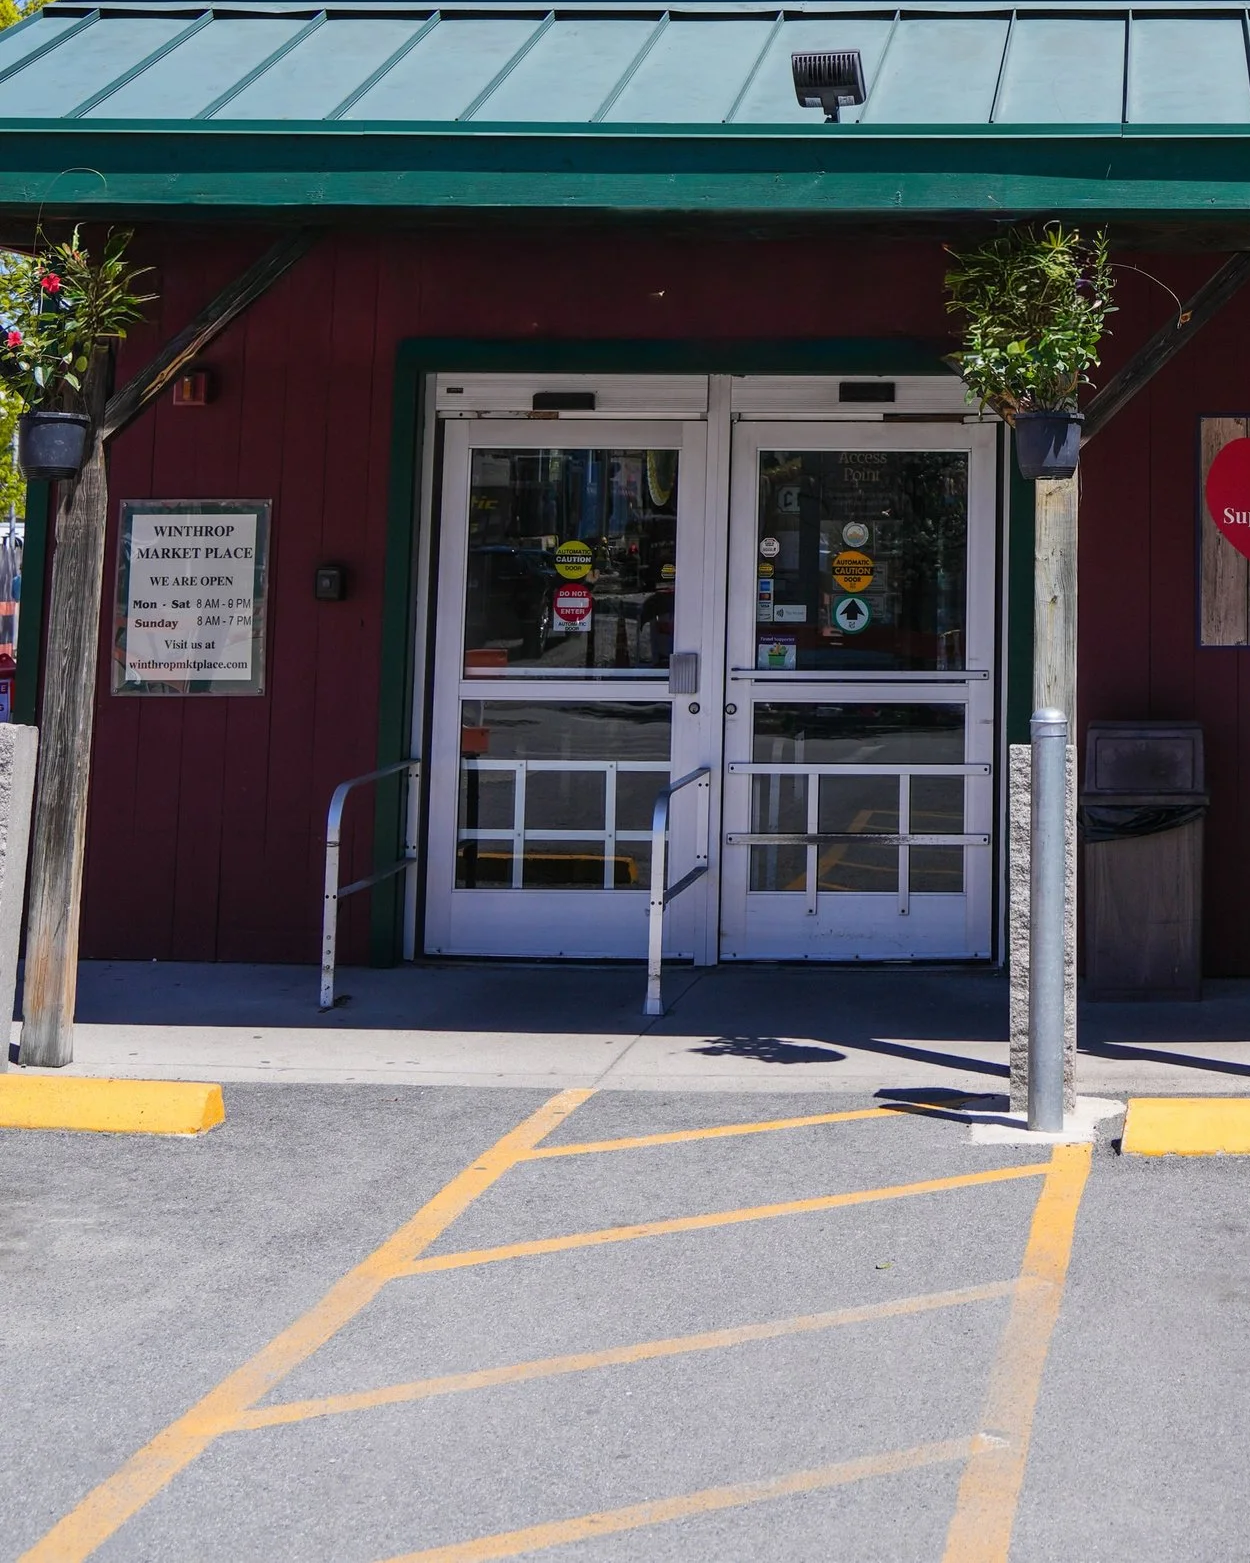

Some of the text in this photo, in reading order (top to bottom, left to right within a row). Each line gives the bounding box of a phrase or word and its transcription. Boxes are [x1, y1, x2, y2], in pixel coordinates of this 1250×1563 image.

[154, 525, 234, 537] WINTHROP
[137, 547, 253, 559] MARKET PLACE
[834, 567, 871, 575] CAUTION
[149, 576, 234, 586] WE ARE OPEN
[133, 599, 157, 609] Mon
[171, 599, 190, 609] Sat
[196, 598, 201, 609] 8
[204, 598, 220, 609] AM
[236, 598, 251, 609] PM
[134, 618, 179, 629] Sunday
[197, 615, 202, 626] 8
[204, 615, 220, 626] AM
[229, 615, 234, 626] 7
[236, 615, 252, 626] PM
[164, 640, 188, 649] Visit
[204, 640, 215, 649] at
[129, 660, 248, 671] winthropmktplace.com
